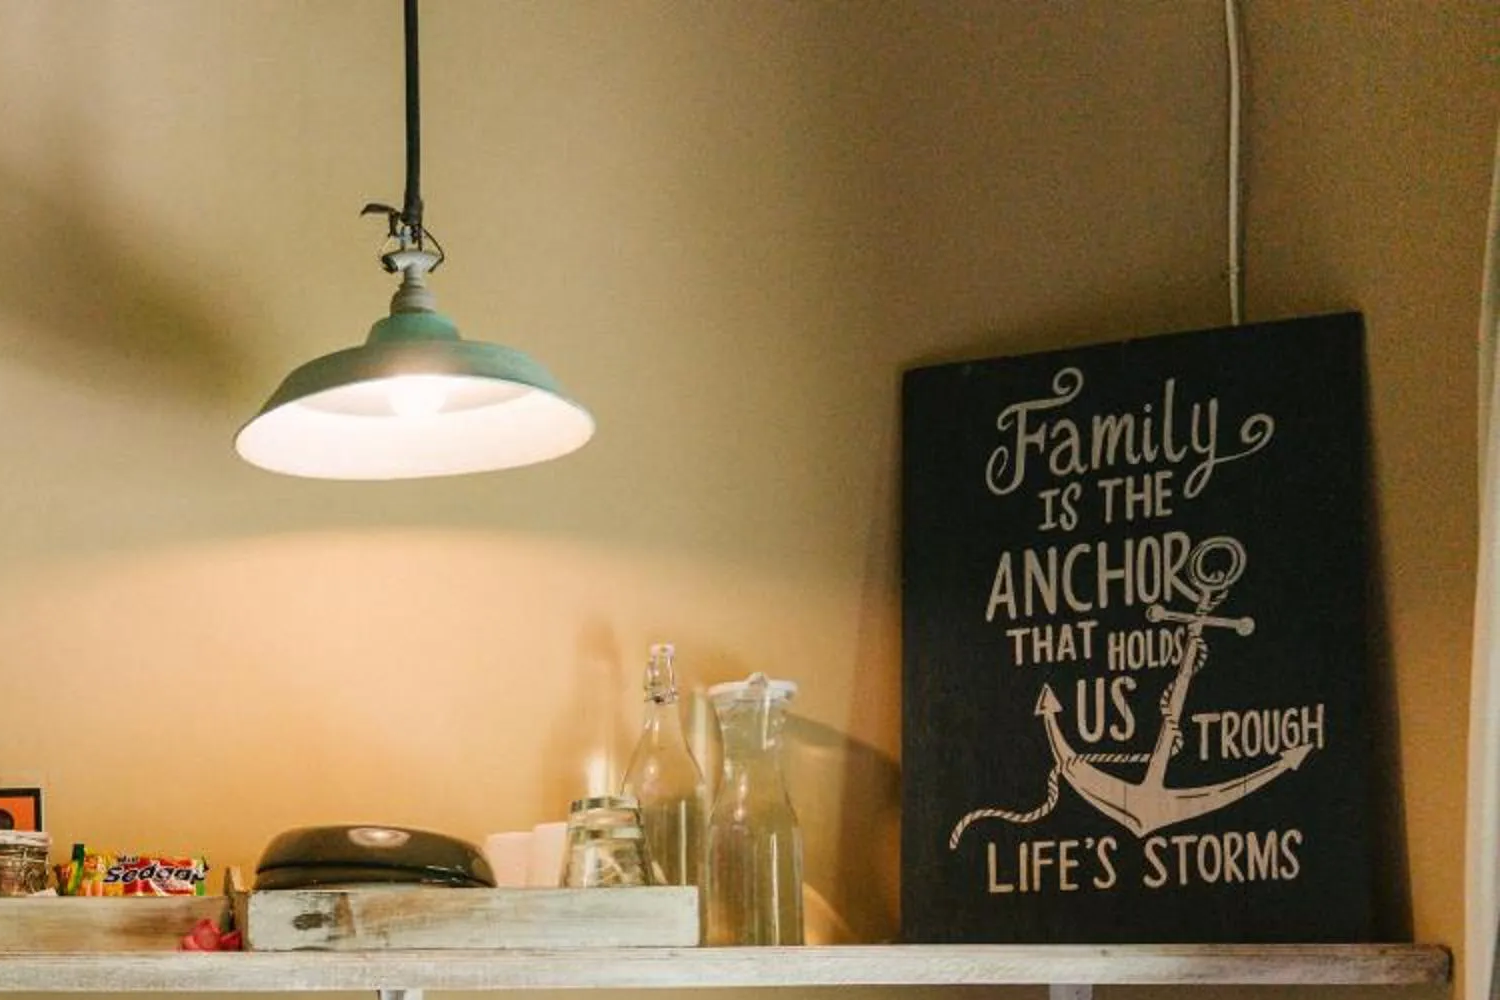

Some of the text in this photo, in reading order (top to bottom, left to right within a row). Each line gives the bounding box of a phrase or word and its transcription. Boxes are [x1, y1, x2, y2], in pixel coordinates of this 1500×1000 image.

[986, 366, 1274, 498] Family
[1038, 470, 1174, 531] IS THE
[985, 530, 1203, 622] ANCHOR
[1006, 621, 1186, 672] THAT HOLDS
[1076, 676, 1137, 743] US
[1192, 703, 1326, 761] TROUGH
[987, 829, 1304, 893] LIFE'S STORMS
